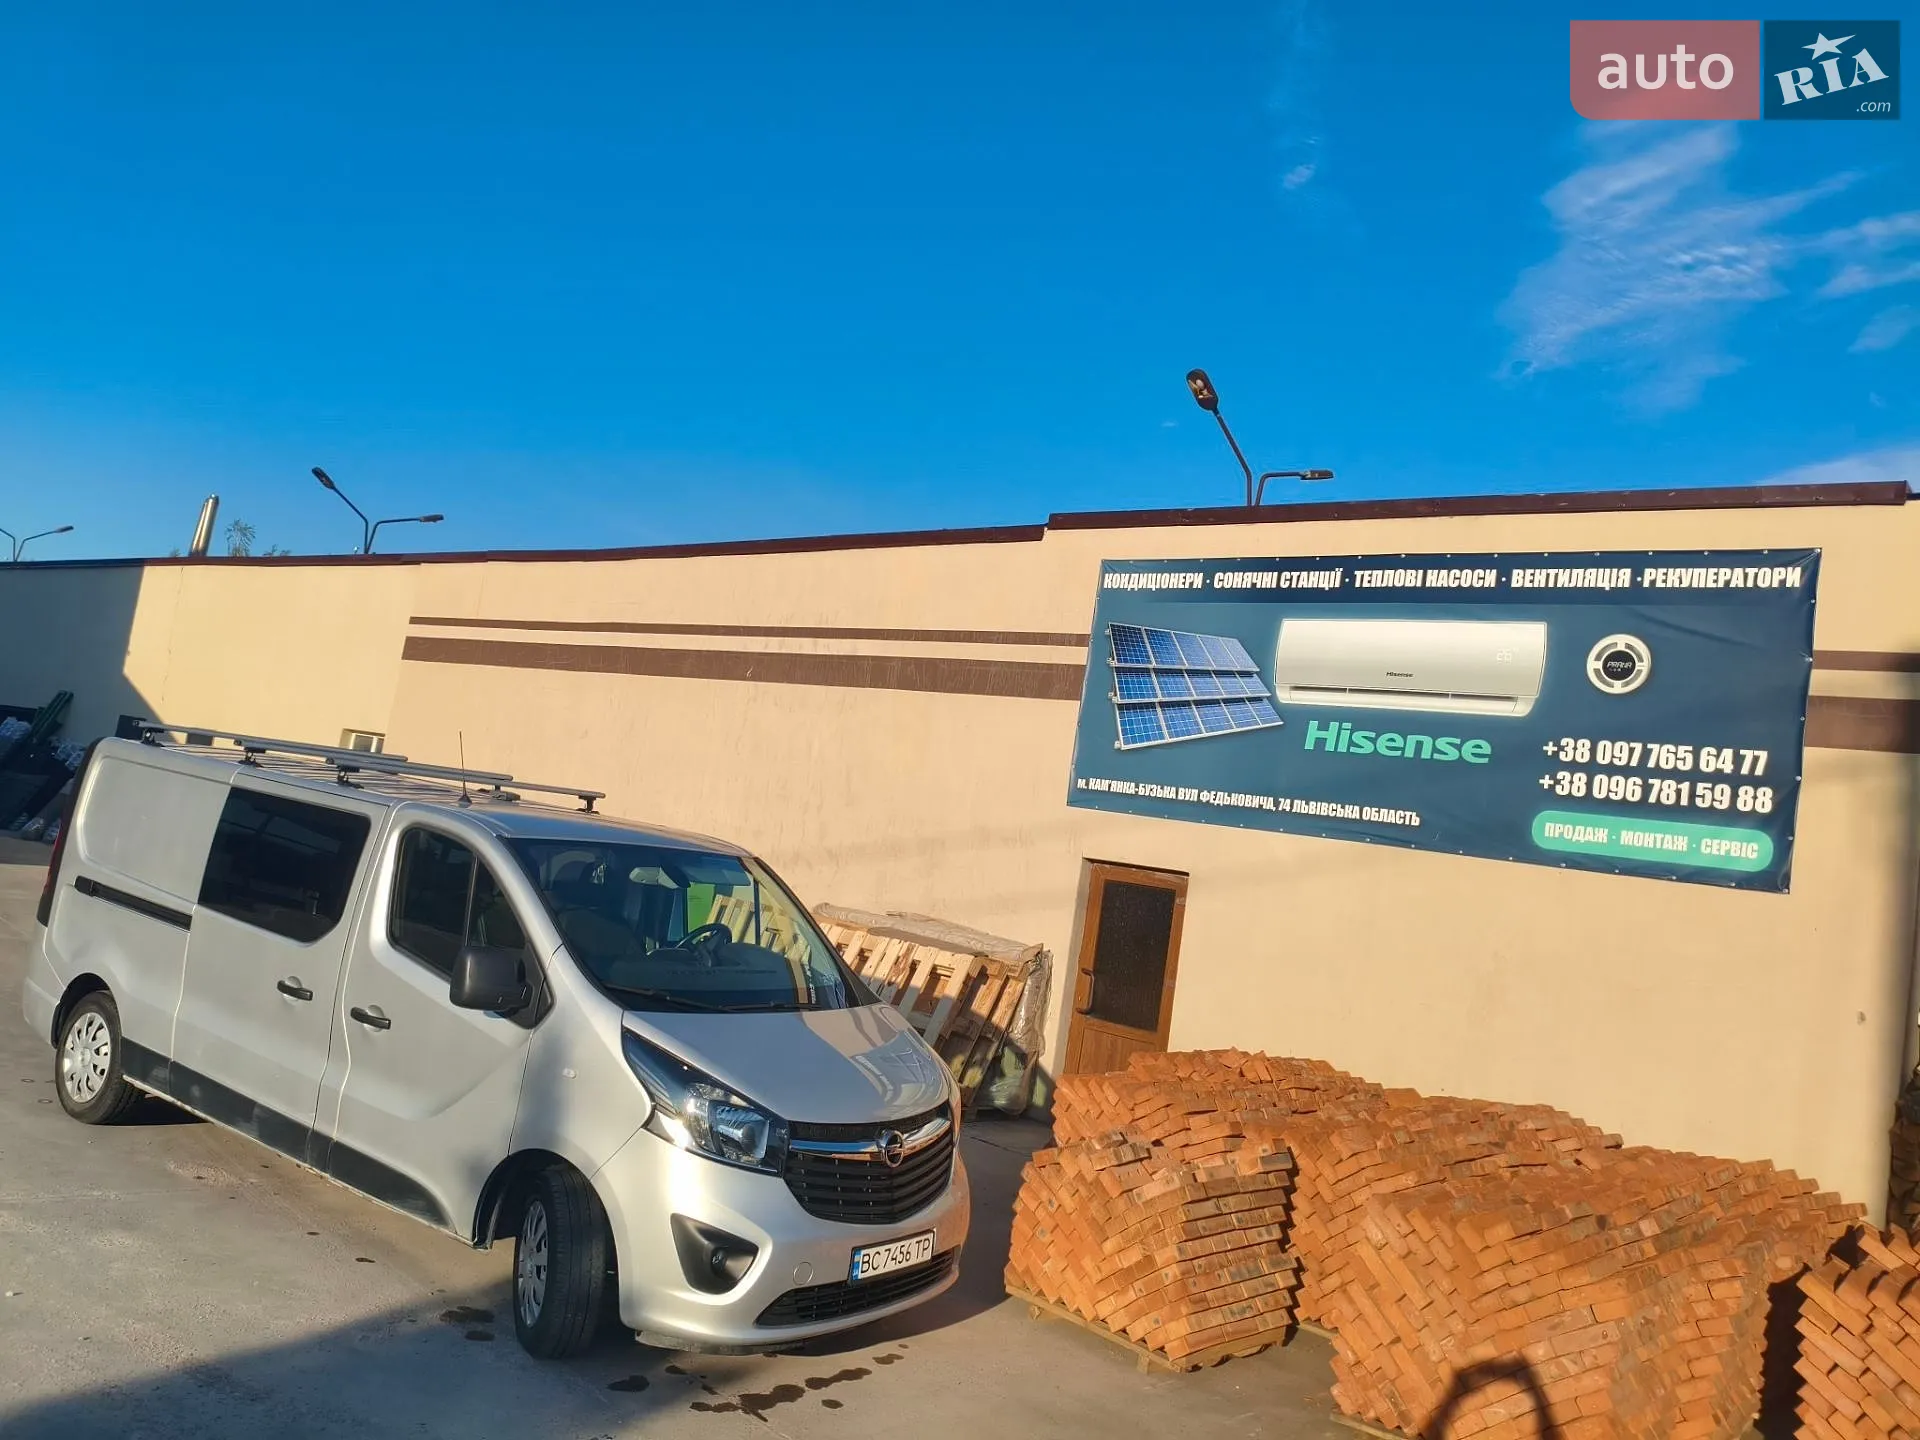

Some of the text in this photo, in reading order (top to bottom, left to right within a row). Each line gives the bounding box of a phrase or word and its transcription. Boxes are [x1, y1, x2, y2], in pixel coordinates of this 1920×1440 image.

[1103, 567, 1801, 591] КОНДИЦІОНЕРИ СОНЯЧНІ СТАНЦІЇ ТЕПЛОВІ НАСОСИ ВЕНТИЛЯЦІЯ РЕКУПЕРАТОРИ
[1304, 720, 1492, 764] Hisense
[1543, 738, 1768, 776] +38 097 765 64 77
[1177, 787, 1199, 801] ВУЛ
[1199, 790, 1276, 811] ФЕДЬКОВИЧА,
[1277, 797, 1292, 812] 74
[1291, 800, 1360, 820] ЛЬВІВСЬКА
[1362, 806, 1421, 827] ОБЛАСТЬ
[1539, 771, 1774, 814] +38 096 781 59 88
[1544, 822, 1759, 859] ПРОДАЖ МОНТАЖ СЕРВІС
[883, 1244, 912, 1268] 7456
